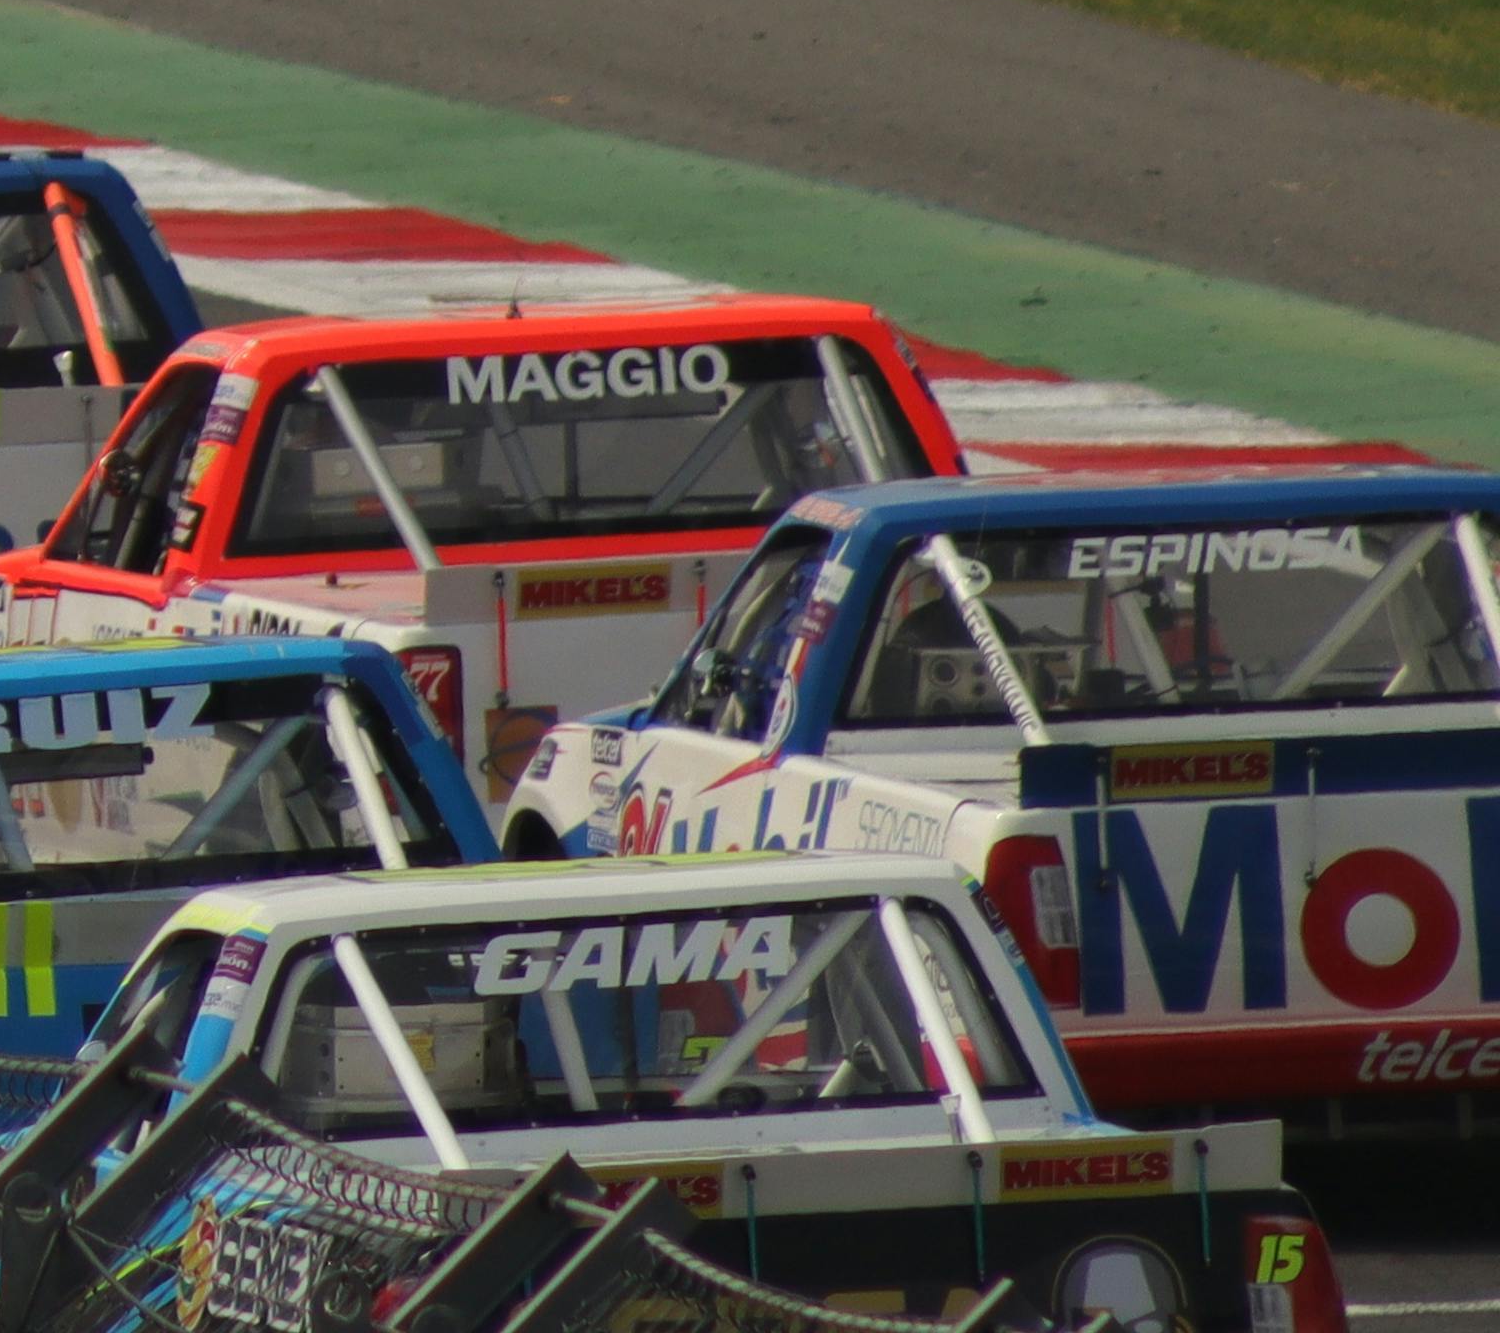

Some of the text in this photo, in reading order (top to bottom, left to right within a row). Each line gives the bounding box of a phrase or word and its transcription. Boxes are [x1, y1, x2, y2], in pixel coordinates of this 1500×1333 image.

[446, 344, 730, 405] MAGGIO
[1067, 525, 1366, 579] ESPINOSA
[520, 574, 668, 609] MIKEL'S
[409, 657, 451, 701] 77
[1114, 752, 1270, 788] MIKEL'S
[473, 915, 794, 996] GAMA
[1004, 1150, 1172, 1190] MIKEL'S
[1256, 1233, 1307, 1285] 15
